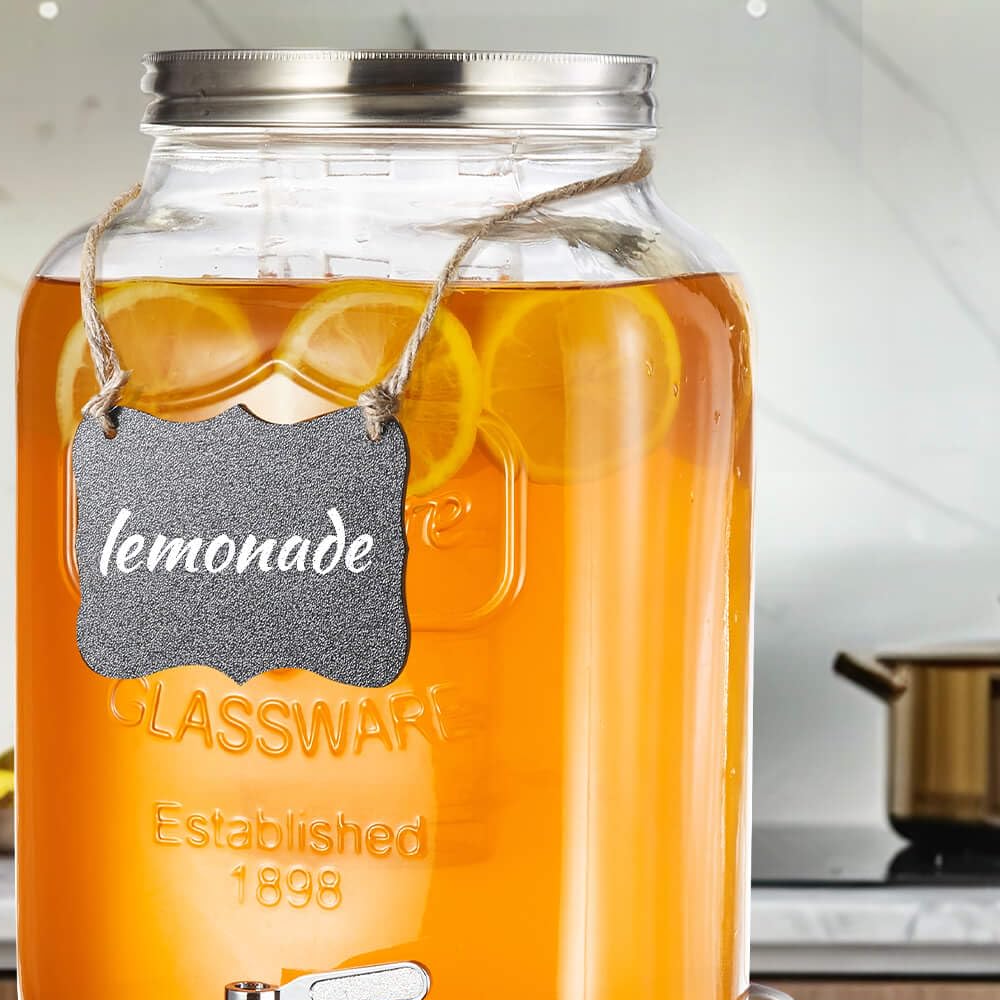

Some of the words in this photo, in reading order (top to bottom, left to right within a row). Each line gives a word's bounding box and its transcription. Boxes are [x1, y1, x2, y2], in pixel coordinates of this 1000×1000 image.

[100, 507, 374, 577] lemonade
[153, 801, 426, 857] Established
[230, 864, 342, 910] 1898
